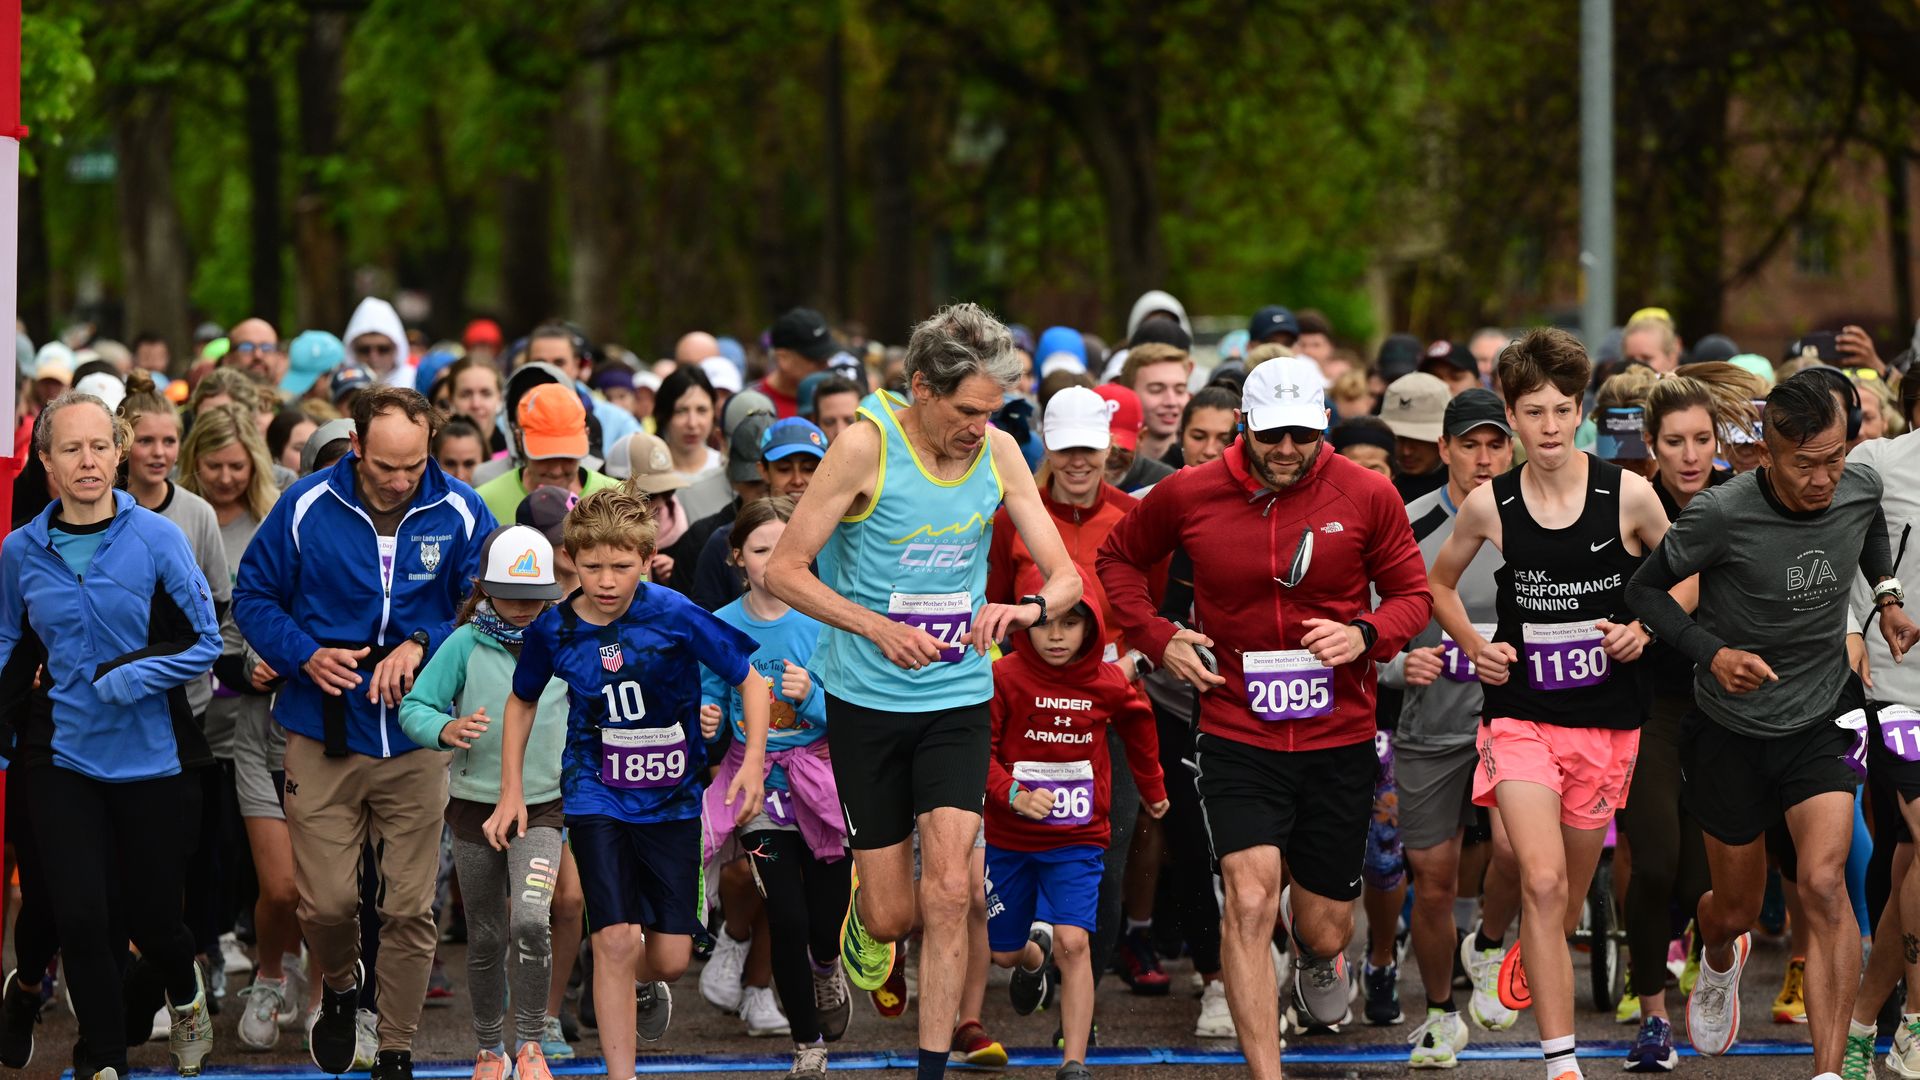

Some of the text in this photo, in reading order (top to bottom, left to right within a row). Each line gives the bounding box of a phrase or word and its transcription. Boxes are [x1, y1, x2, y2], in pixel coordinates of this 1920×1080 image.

[1514, 569, 1552, 583] PEAK.
[1514, 573, 1622, 597] PERFORMANCE
[1516, 596, 1580, 611] RUNNING
[600, 644, 619, 658] USA
[752, 658, 768, 672] The
[1529, 646, 1608, 682] 1130
[601, 680, 646, 723] 10
[1248, 677, 1329, 713] 2095
[1035, 697, 1092, 711] UNDER
[1024, 729, 1093, 744] ARMOUR
[607, 750, 686, 782] 1859
